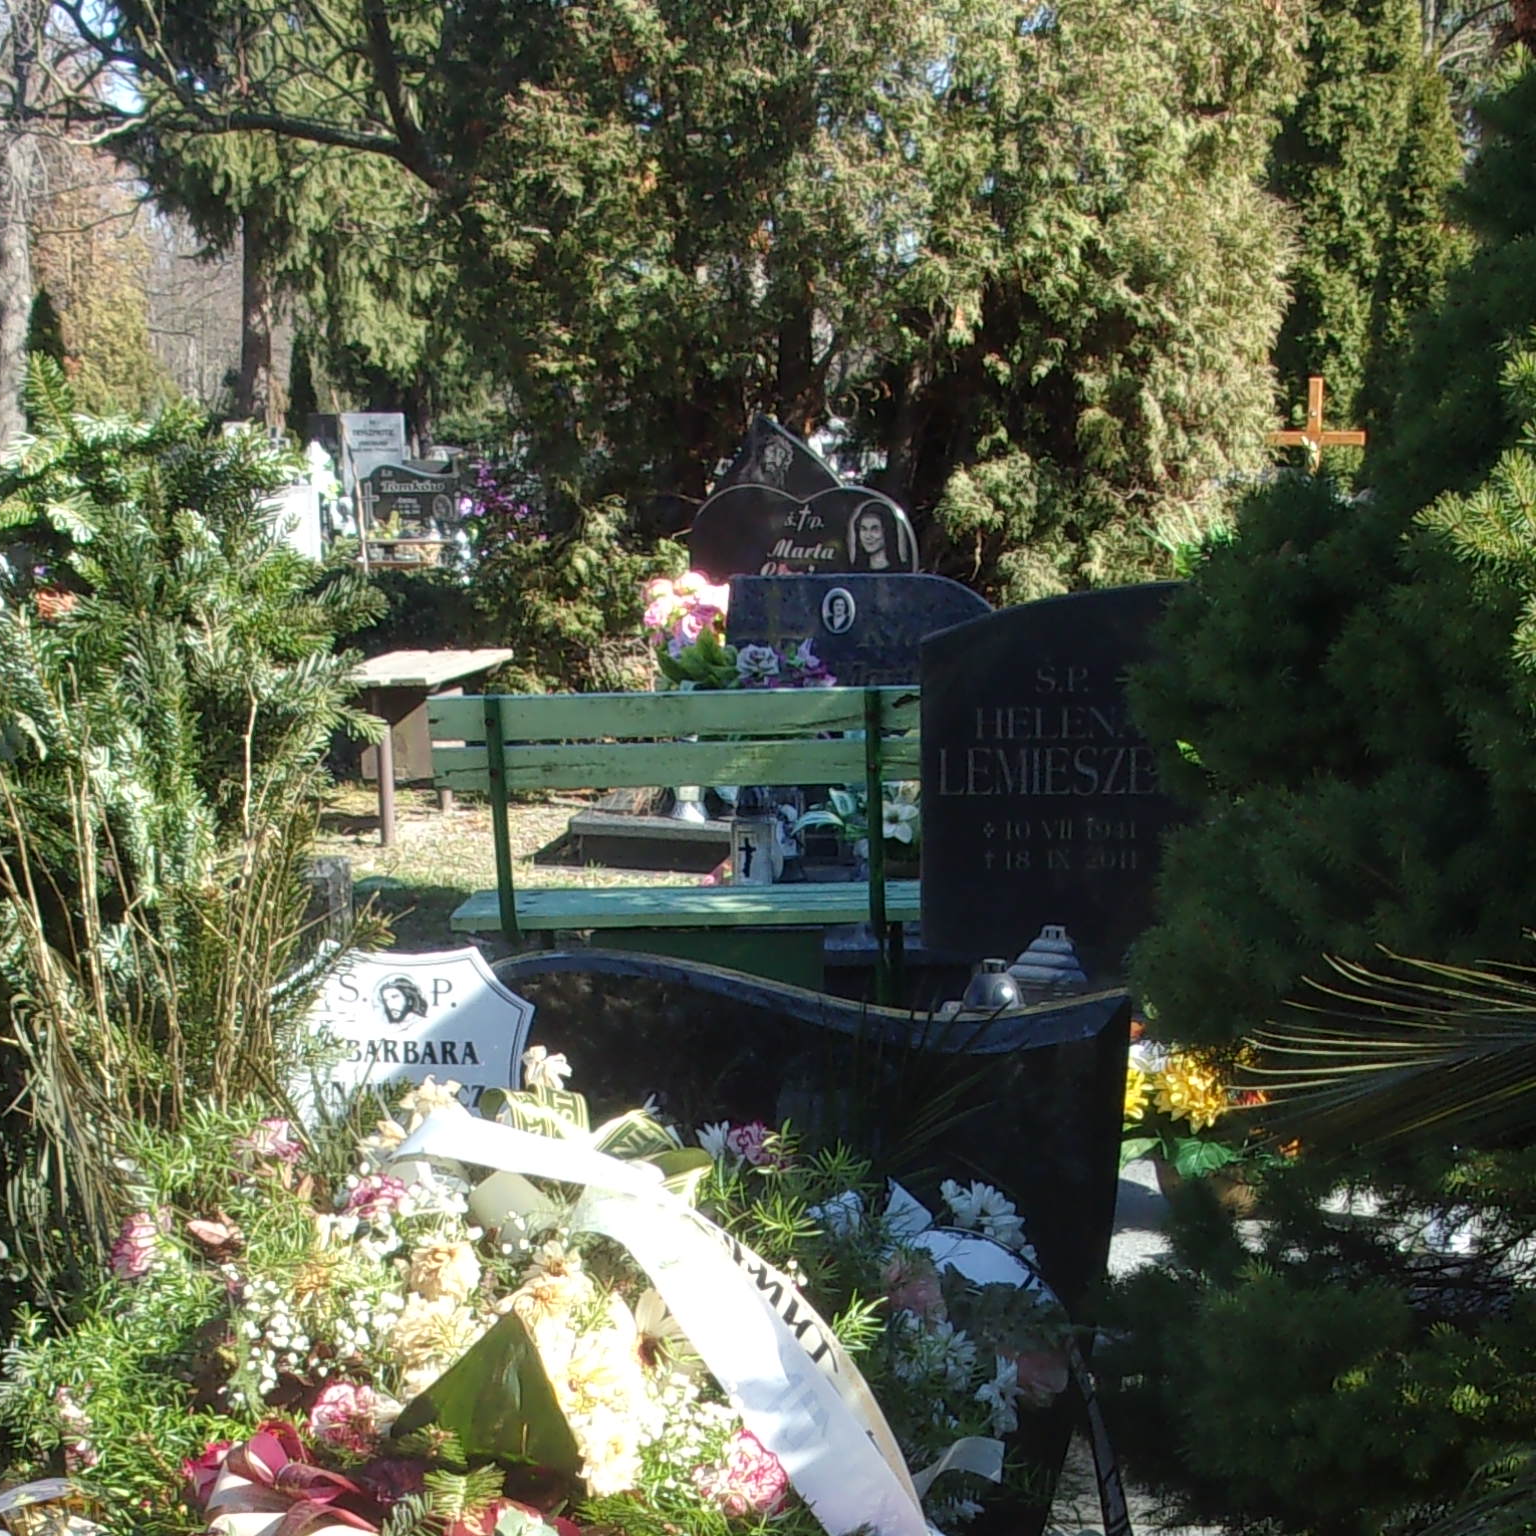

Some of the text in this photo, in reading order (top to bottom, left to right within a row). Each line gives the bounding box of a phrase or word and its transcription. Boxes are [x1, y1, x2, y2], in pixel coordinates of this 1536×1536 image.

[975, 705, 1126, 741] HELEN
[938, 748, 1163, 796] LEMIESZE
[346, 1039, 480, 1065] BARBARA
